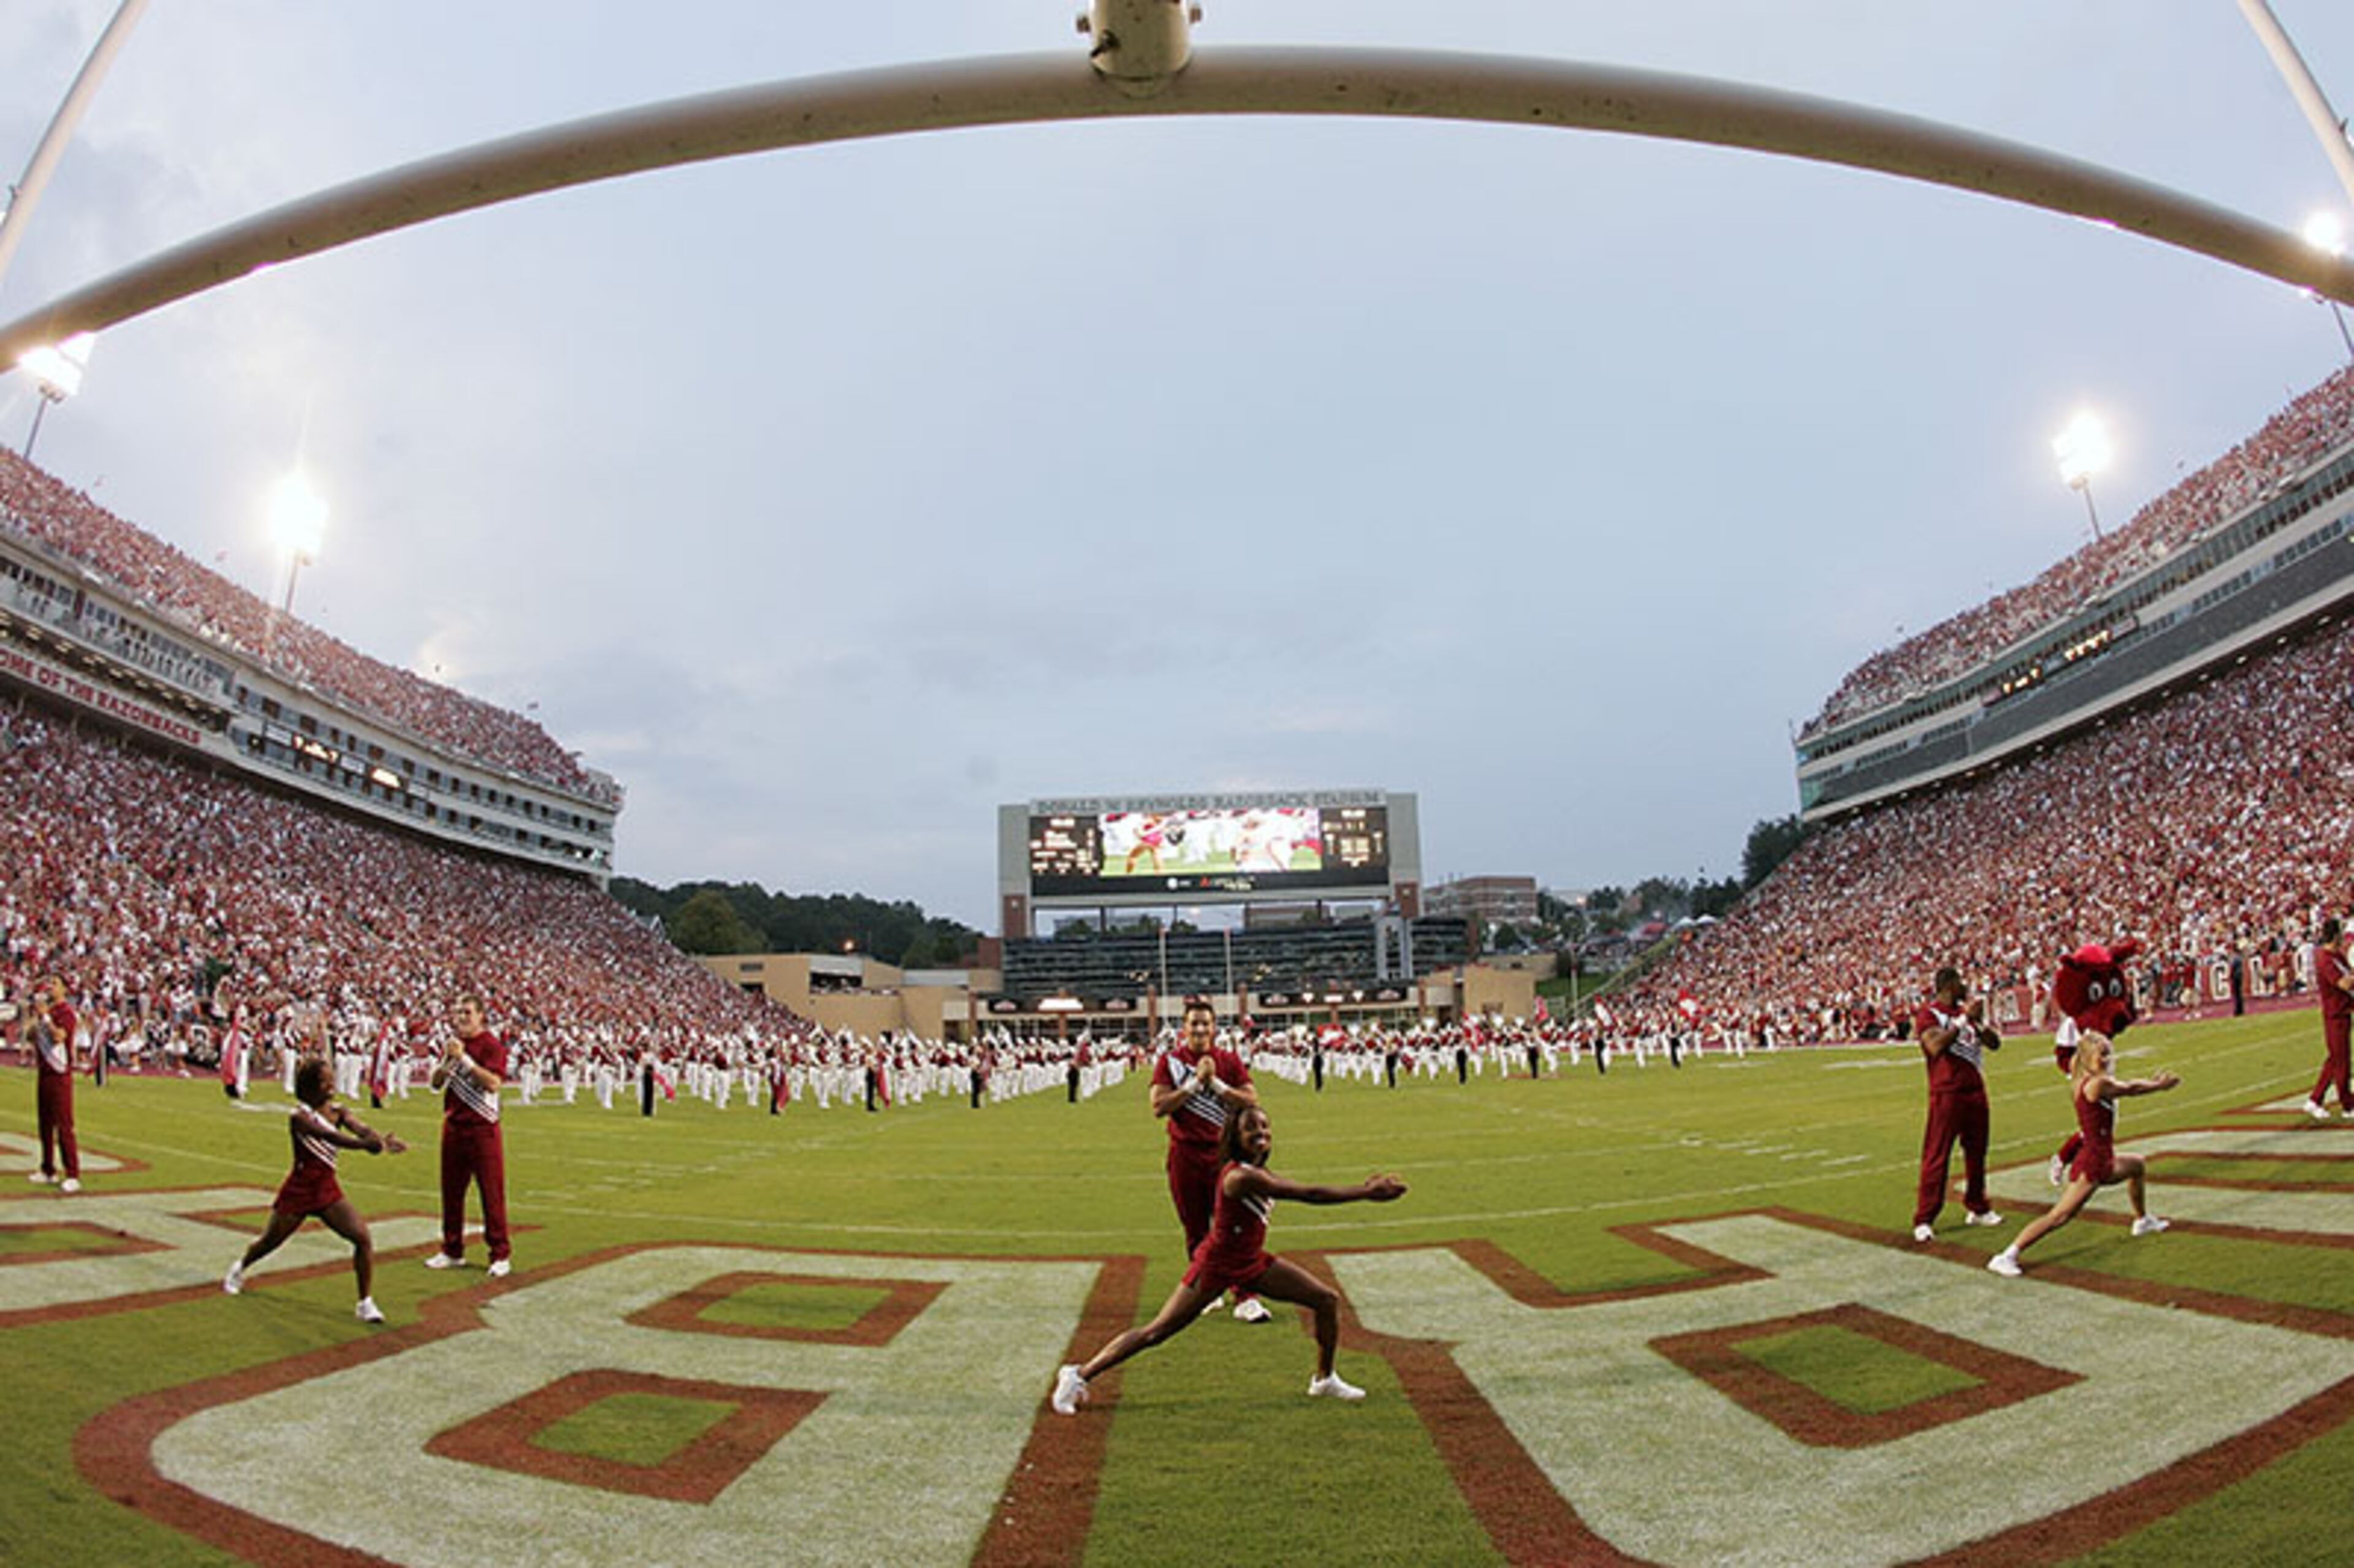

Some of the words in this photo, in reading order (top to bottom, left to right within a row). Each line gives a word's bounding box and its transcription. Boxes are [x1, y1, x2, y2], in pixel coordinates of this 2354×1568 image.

[39, 668, 61, 686] OF
[66, 678, 94, 702] THE
[98, 693, 201, 744] RAZORBACKS
[1214, 793, 1306, 808] RAZORBACK
[1314, 790, 1380, 804] STADIUM
